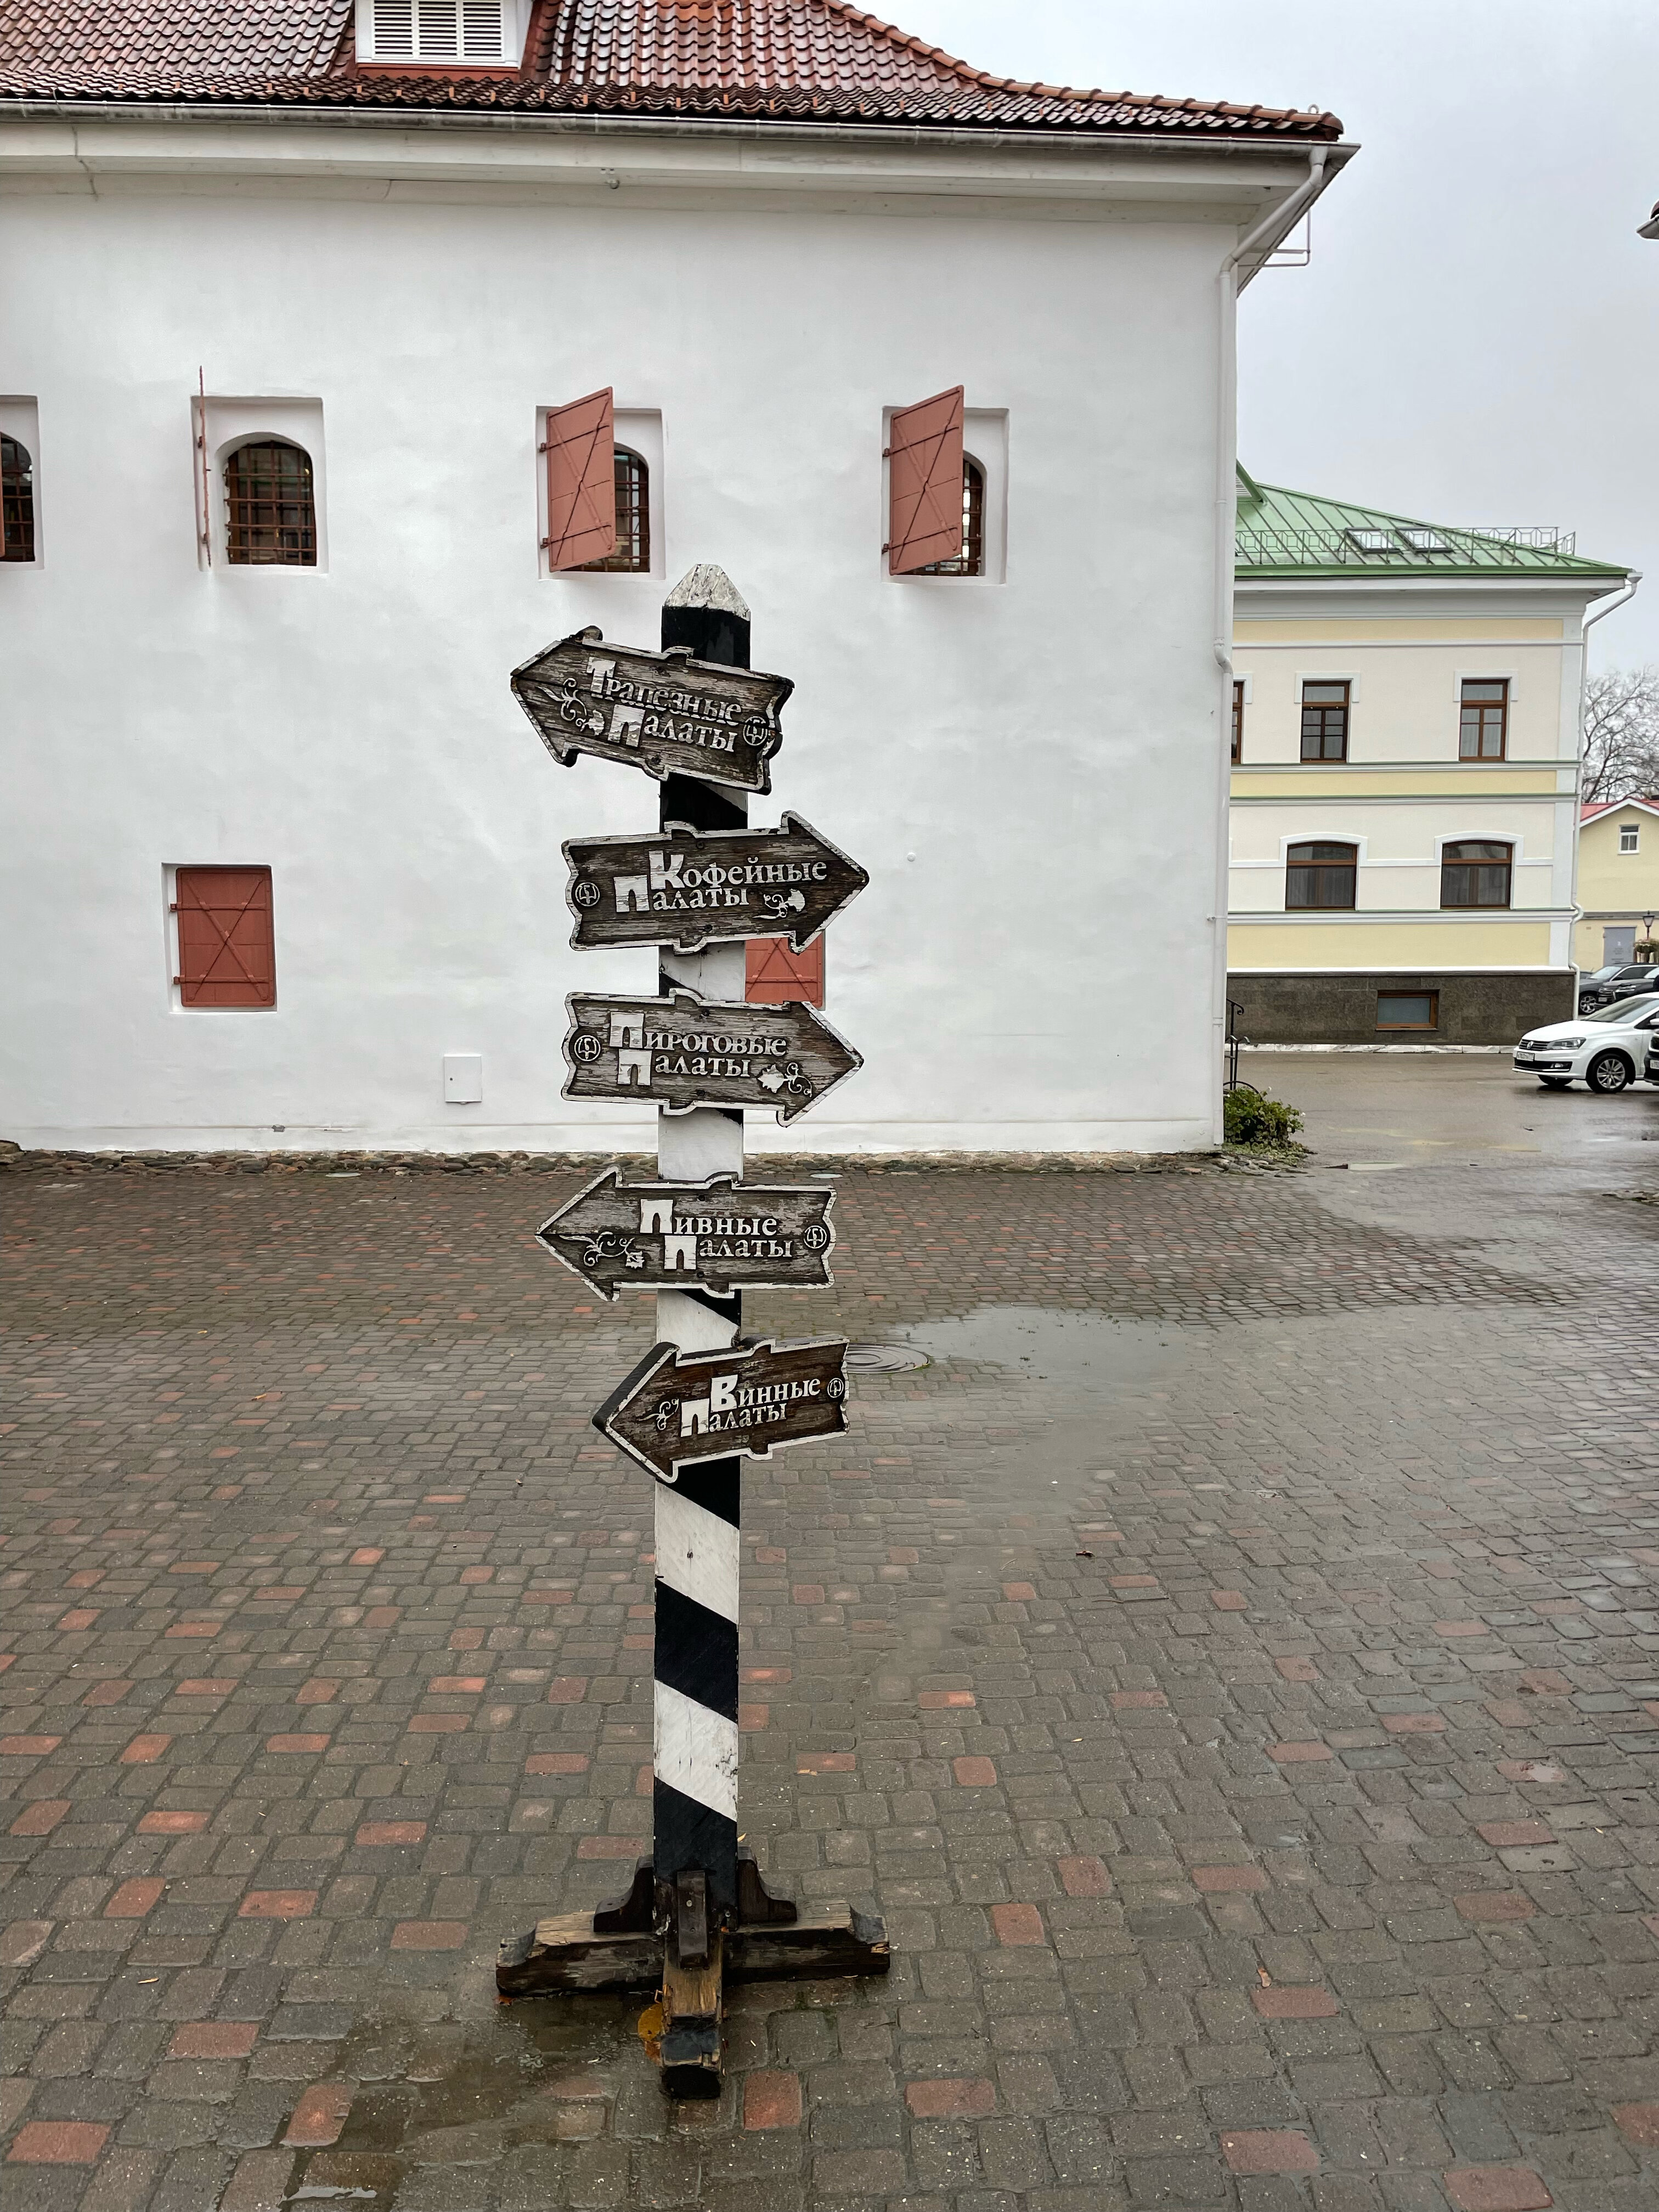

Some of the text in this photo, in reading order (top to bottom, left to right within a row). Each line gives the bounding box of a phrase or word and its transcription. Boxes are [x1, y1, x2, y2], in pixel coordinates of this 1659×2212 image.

[586, 657, 742, 726] Трапезные
[607, 704, 737, 753] Палаты
[648, 850, 827, 889] Кофейные
[613, 875, 749, 912] Палаты
[610, 1012, 786, 1056] Пироговые
[617, 1048, 750, 1086] Палаты
[640, 1199, 777, 1235] Пивные
[664, 1235, 793, 1270] Палаты
[710, 1374, 820, 1413] Винные
[680, 1398, 787, 1437] Палаты
